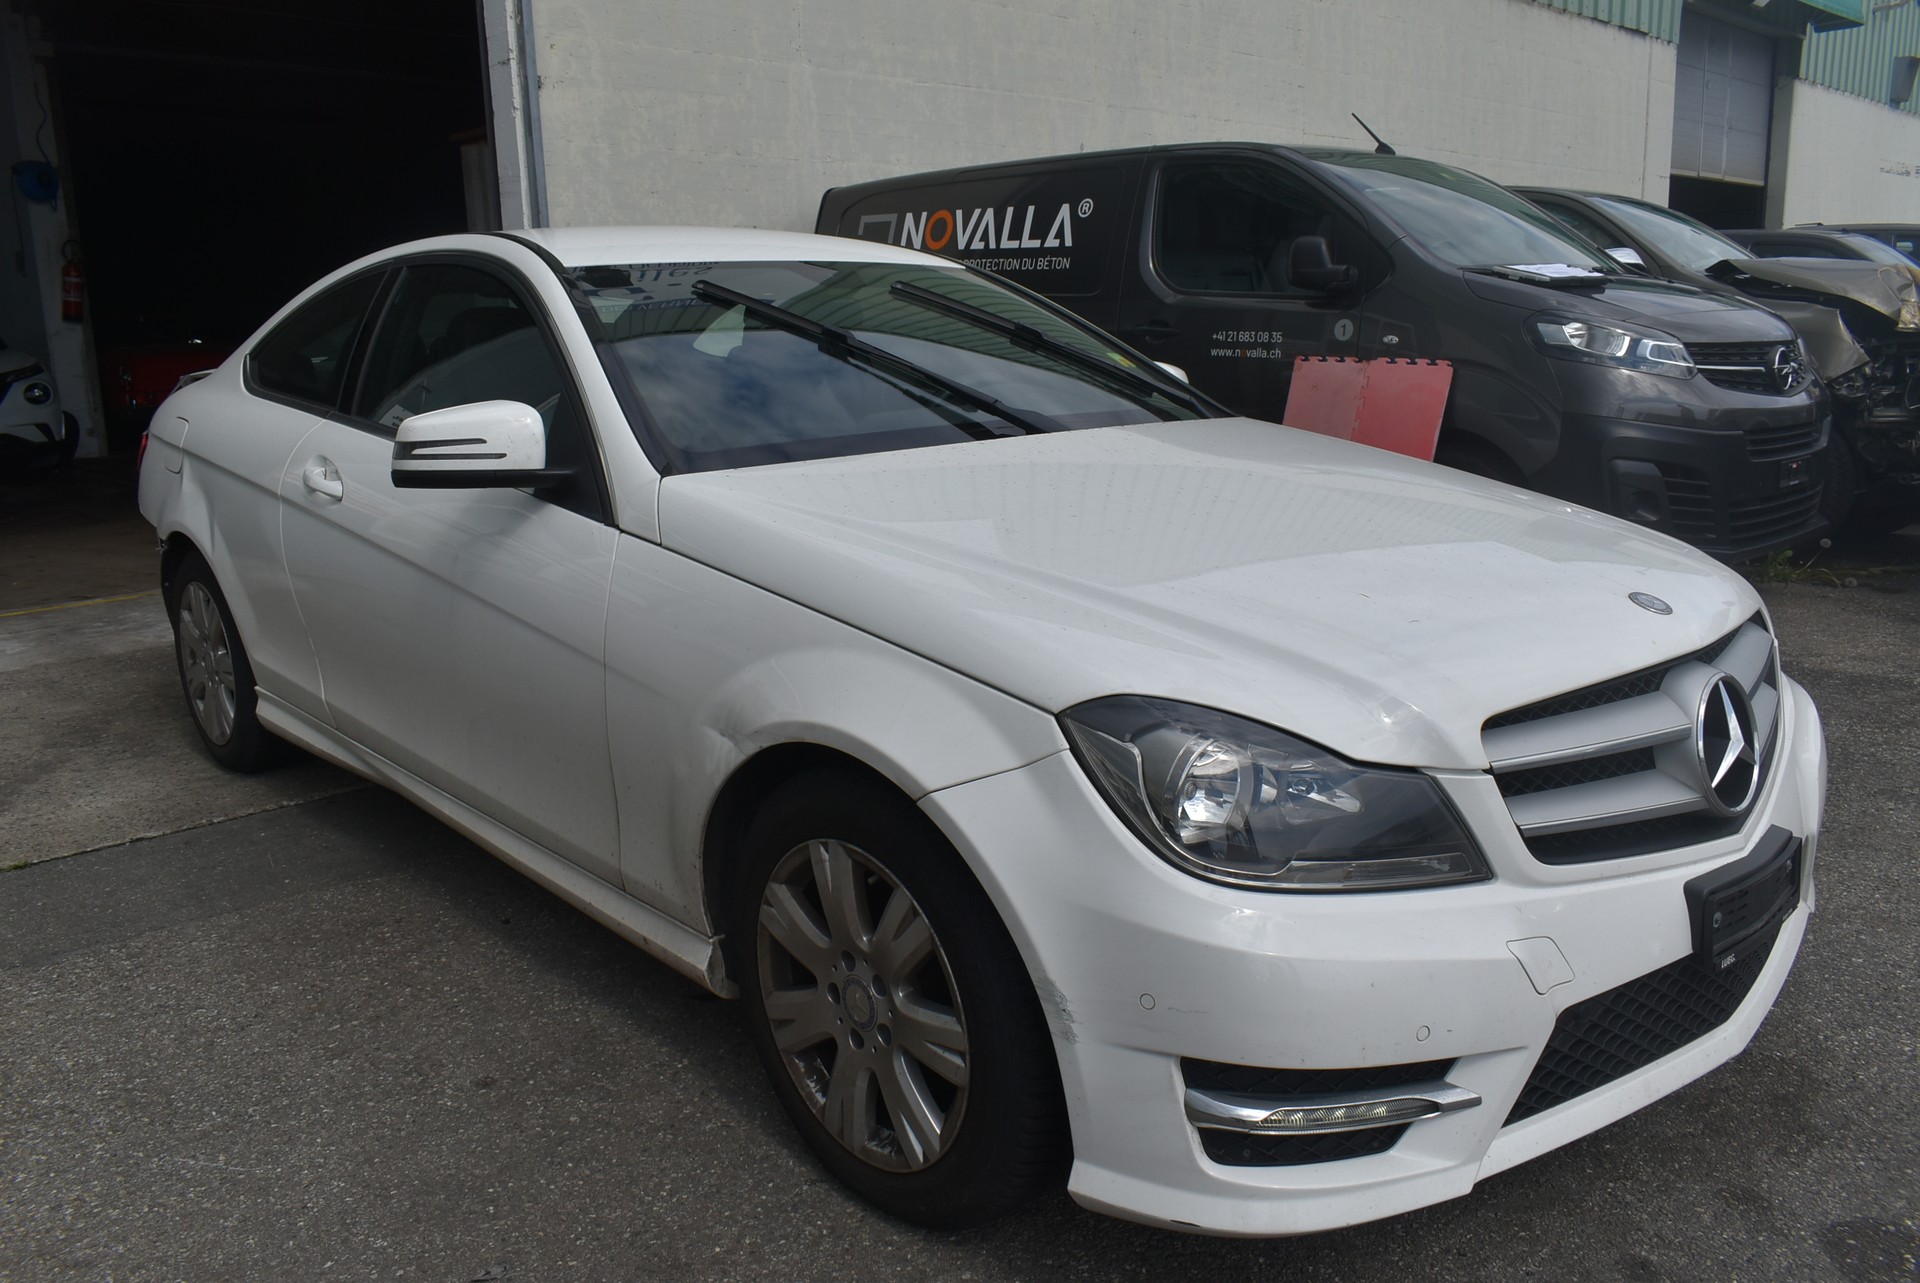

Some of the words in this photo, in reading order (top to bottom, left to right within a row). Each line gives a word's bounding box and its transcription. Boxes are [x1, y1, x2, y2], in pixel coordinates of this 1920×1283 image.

[1021, 258, 1036, 270] DU
[1036, 255, 1071, 270] BÉTON
[1211, 331, 1226, 341] +41
[1227, 331, 1237, 342] 21
[1238, 331, 1256, 342] 683
[1257, 331, 1269, 343] 08
[1270, 331, 1283, 343] 35
[1210, 347, 1282, 359] www.novalla.ch
